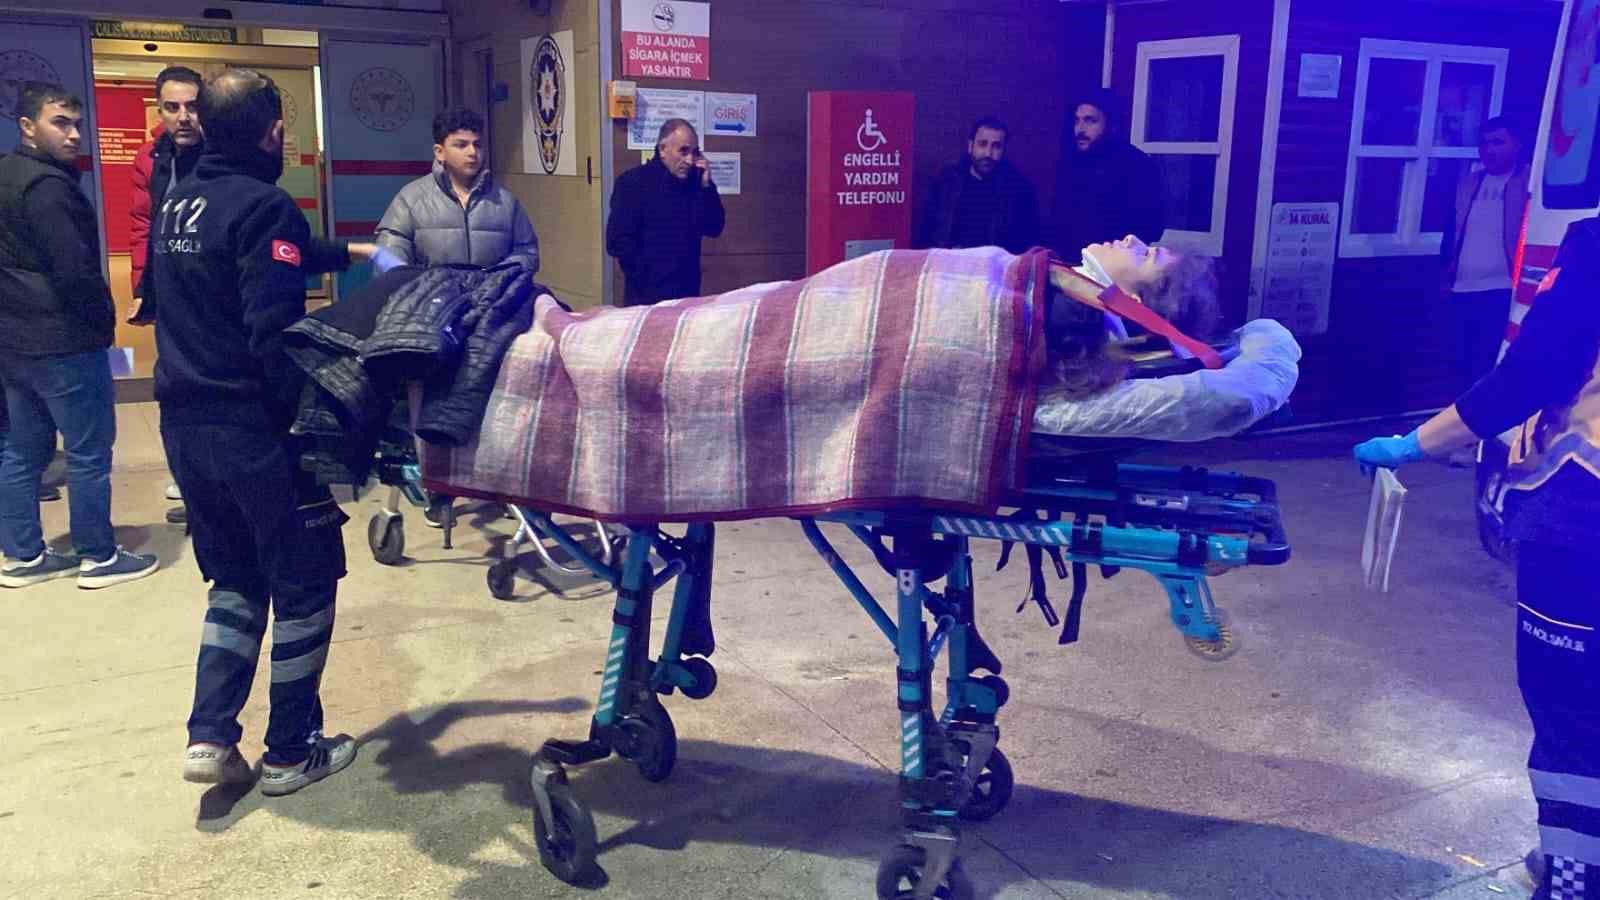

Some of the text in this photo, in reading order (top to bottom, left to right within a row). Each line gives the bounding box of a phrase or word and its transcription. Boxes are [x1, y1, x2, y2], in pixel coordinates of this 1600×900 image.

[636, 34, 696, 48] BU ALANDA
[629, 47, 704, 64] SİGARA İÇMEK
[640, 64, 692, 77] YASAKTIR
[843, 150, 901, 167] ENGELLİ
[844, 172, 899, 185] YARDIM
[837, 191, 905, 205] TELEFONU
[160, 196, 207, 234] 112
